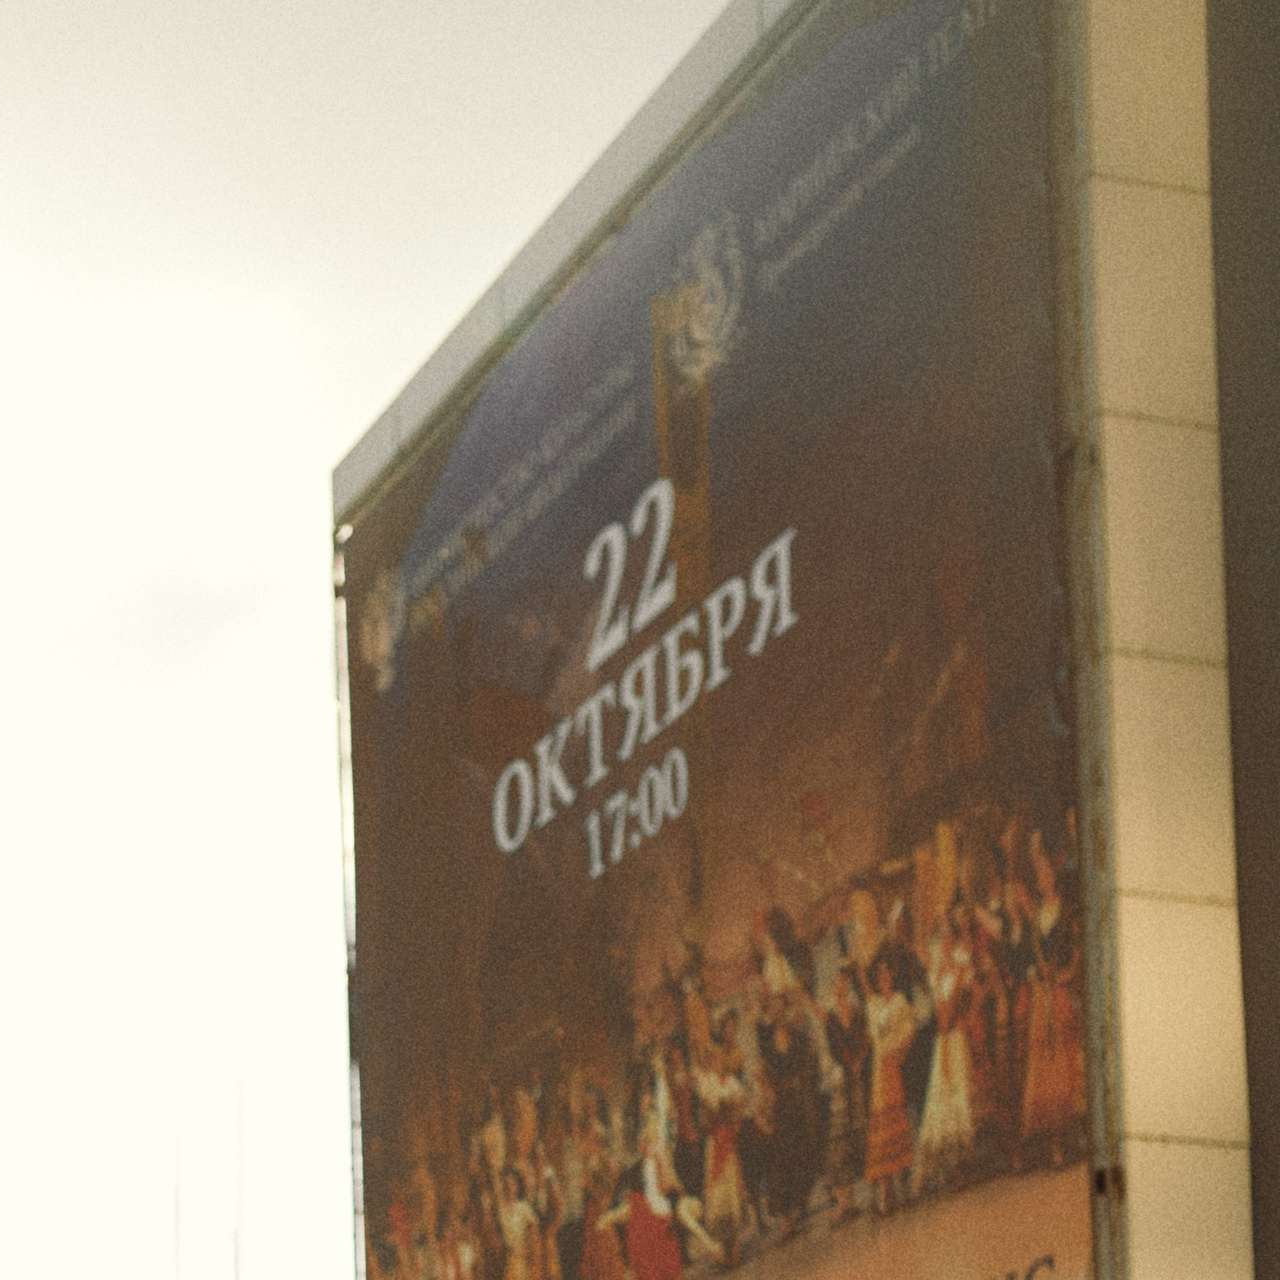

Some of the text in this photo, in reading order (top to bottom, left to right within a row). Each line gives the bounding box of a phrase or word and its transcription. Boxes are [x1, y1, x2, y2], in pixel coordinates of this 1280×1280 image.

[584, 478, 677, 673] 22
[493, 526, 800, 853] ОКТЯБРЯ
[584, 747, 689, 880] 17:00
